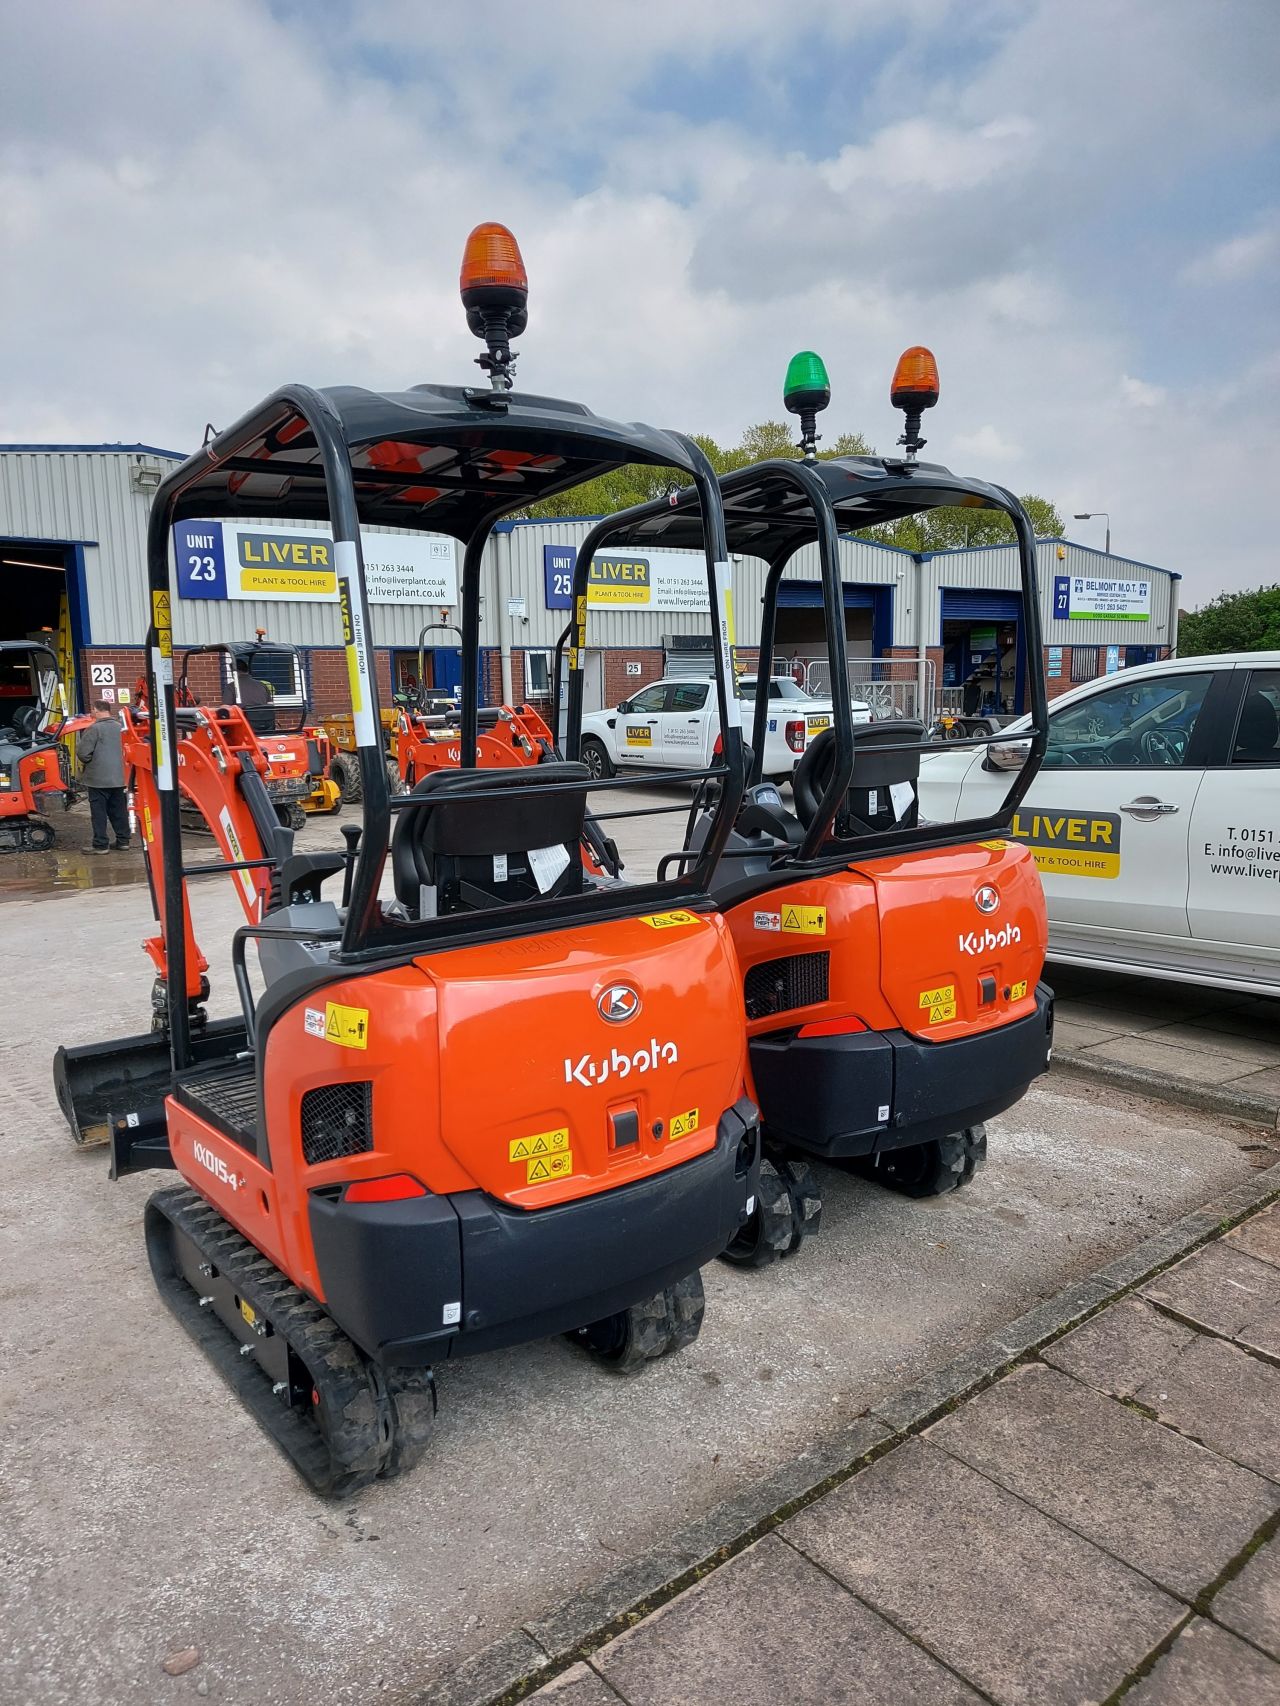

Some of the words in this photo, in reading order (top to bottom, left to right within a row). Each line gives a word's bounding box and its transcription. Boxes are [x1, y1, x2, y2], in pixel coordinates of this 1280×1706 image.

[187, 535, 214, 550] UNIT
[243, 540, 329, 566] LIVER
[188, 556, 216, 581] 23
[381, 563, 395, 573] 263
[396, 564, 415, 573] 3444
[553, 557, 571, 569] UNIT
[589, 561, 646, 581] LIVER
[252, 576, 278, 586] PLANT
[280, 577, 287, 585] &
[287, 578, 308, 586] TOOL
[309, 578, 327, 587] HIRE
[371, 575, 447, 587] info@liverplant.co.uk
[553, 574, 571, 595] 25
[667, 578, 680, 586] 0151
[680, 578, 690, 586] 263
[690, 578, 703, 586] 3444
[1086, 581, 1117, 592] BELMONT
[1118, 582, 1137, 592] M.O.T.
[595, 590, 613, 598] PLANT
[632, 591, 644, 599] HIRE
[1058, 594, 1067, 609] 27
[1094, 602, 1106, 611] 0151
[354, 613, 361, 628] ON
[356, 628, 364, 648] HIRE
[358, 650, 366, 675] FROM
[628, 664, 639, 673] 25
[725, 659, 731, 670] ON
[93, 667, 114, 683] 23
[808, 718, 829, 726] LIVER
[627, 728, 650, 737] LIVER
[1012, 814, 1113, 845] LIVER
[1227, 827, 1237, 840] T.
[1242, 828, 1274, 843] 0151
[1204, 843, 1215, 857] E.
[1048, 857, 1056, 866] &
[1057, 858, 1083, 868] TOOL
[1084, 859, 1107, 870] HIRE
[958, 922, 1021, 956] Kubota
[564, 1037, 678, 1087] Kubota
